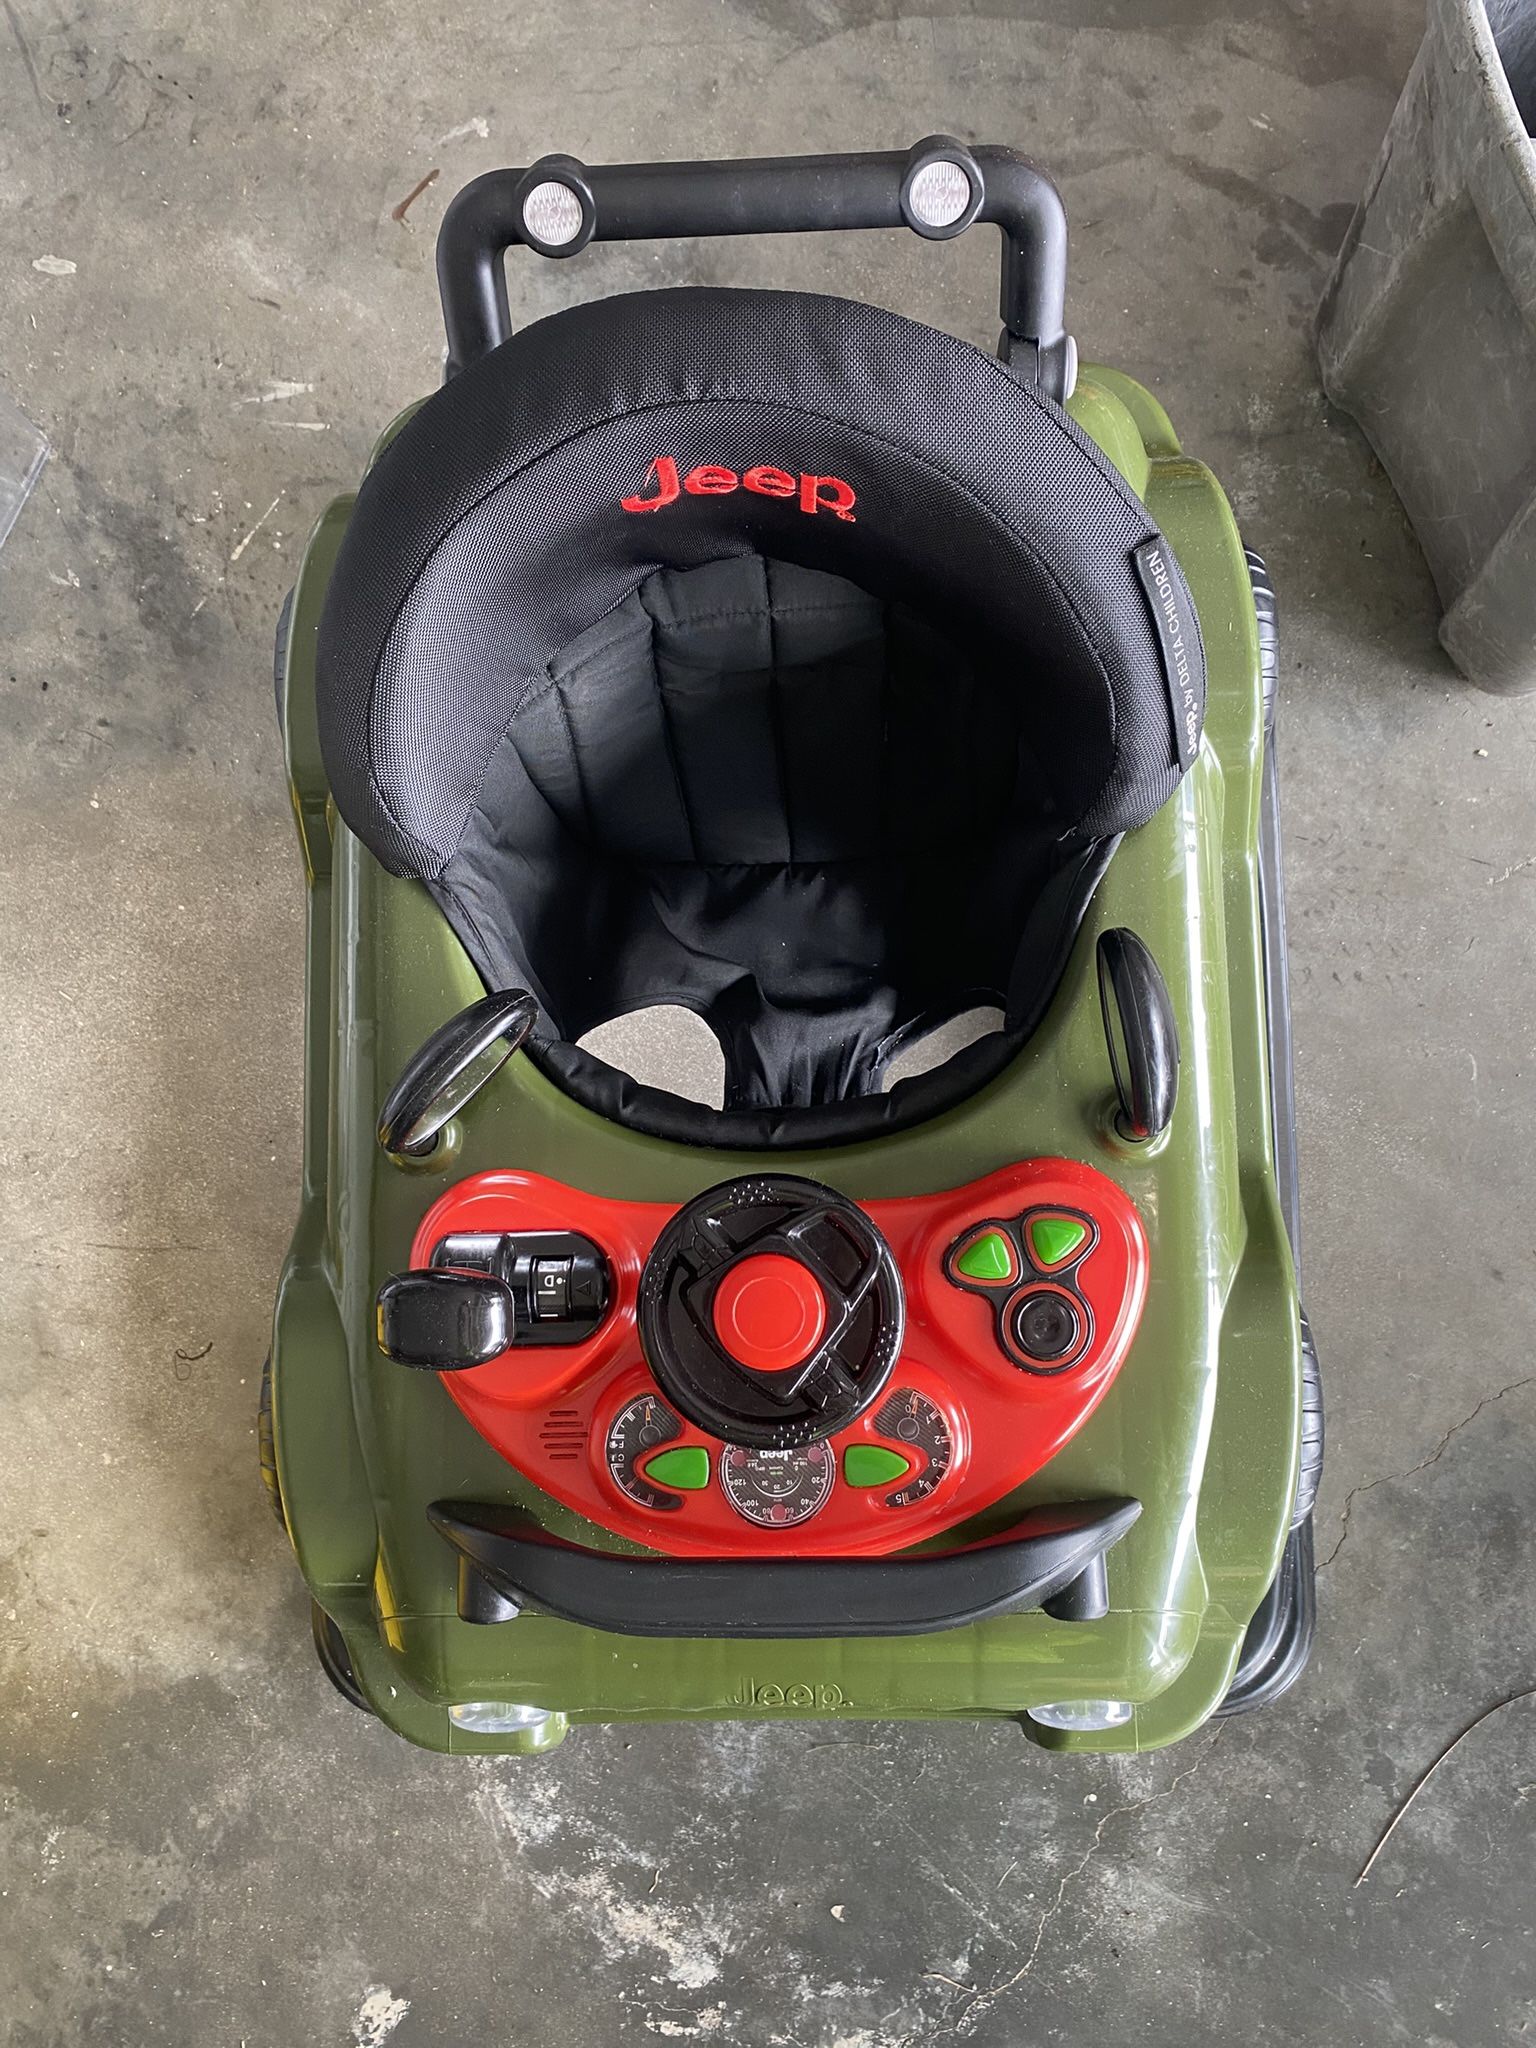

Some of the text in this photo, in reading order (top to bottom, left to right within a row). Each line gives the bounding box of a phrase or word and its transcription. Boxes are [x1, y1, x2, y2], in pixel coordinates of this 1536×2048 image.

[620, 455, 857, 523] Jeep
[1146, 549, 1181, 634] CHILDREN
[1173, 635, 1191, 689] DELTA
[1183, 688, 1195, 709] by
[934, 1435, 941, 1444] 2
[617, 1454, 625, 1462] C
[931, 1457, 939, 1467] 3
[734, 1478, 747, 1486] 120
[811, 1476, 821, 1484] 20
[918, 1479, 925, 1488] 4
[746, 1499, 759, 1507] 100
[800, 1498, 810, 1506] 40
[895, 1494, 902, 1504] 5
